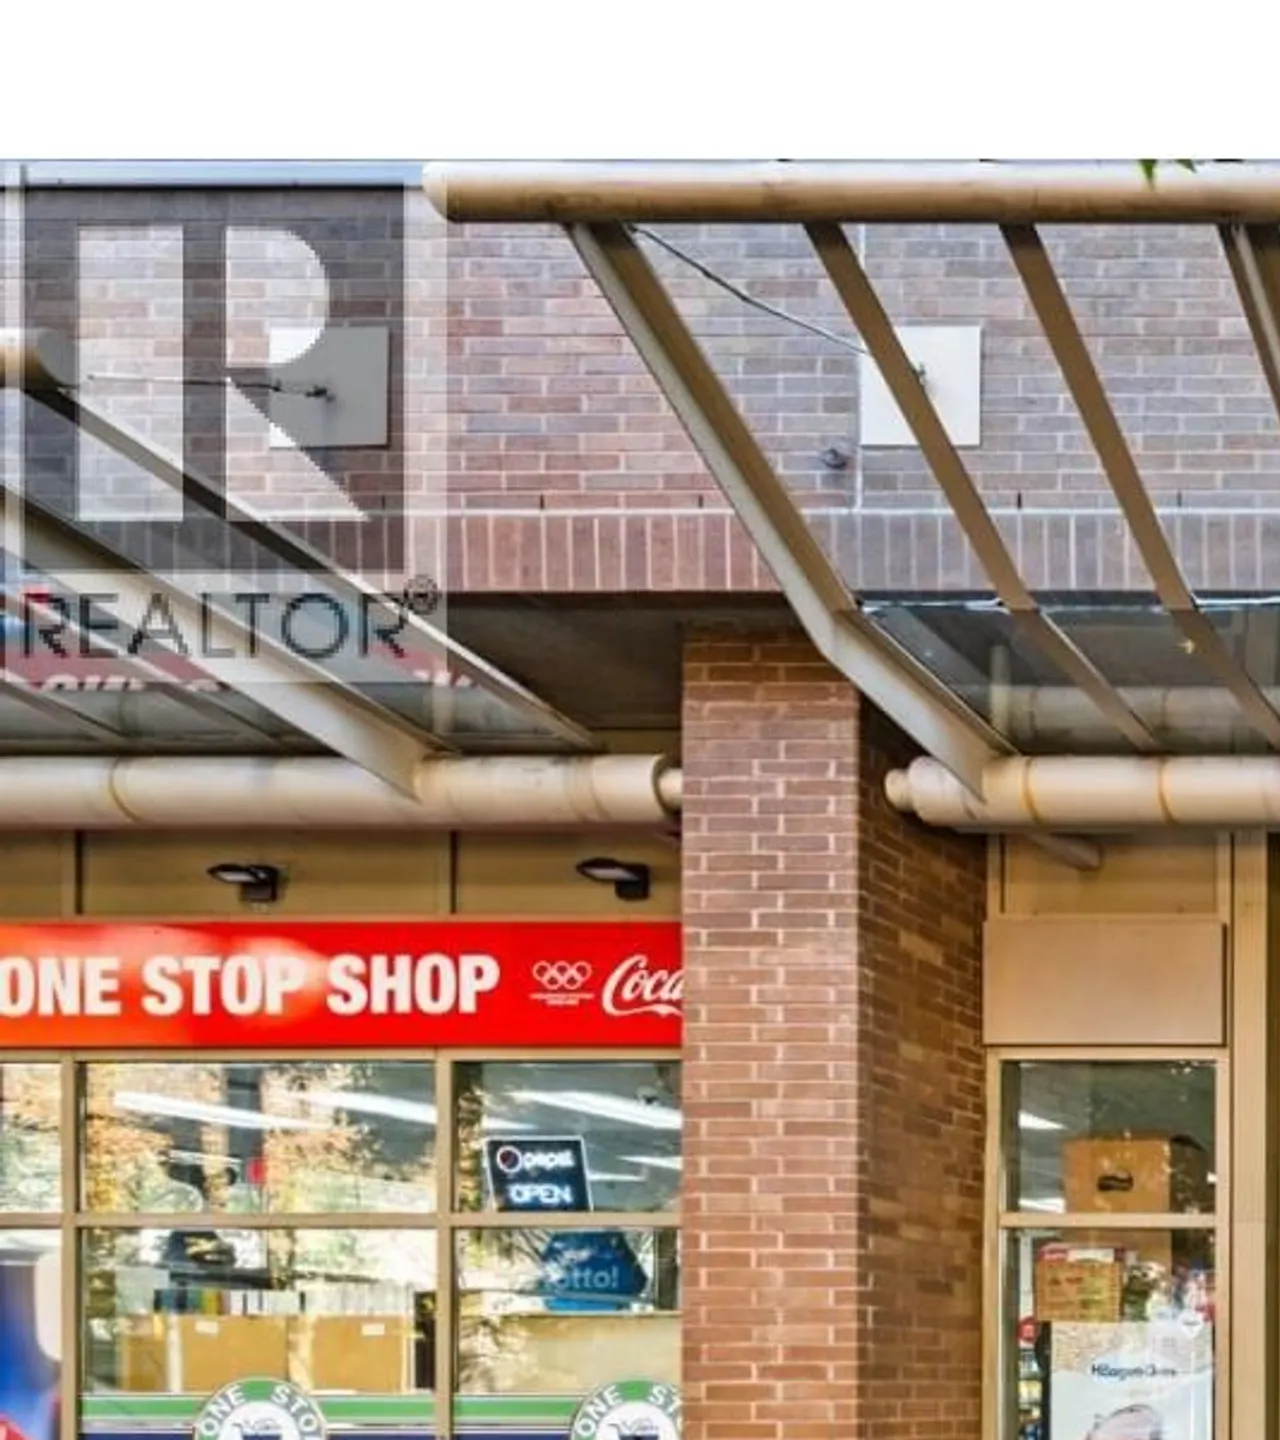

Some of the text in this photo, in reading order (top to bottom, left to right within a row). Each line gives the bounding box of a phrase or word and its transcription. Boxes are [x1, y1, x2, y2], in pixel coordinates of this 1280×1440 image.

[0, 954, 500, 1015] ONE STOP SHOP
[507, 1183, 574, 1205] OPEN
[201, 1384, 245, 1437] ONE
[575, 1384, 684, 1437] ONE ST
